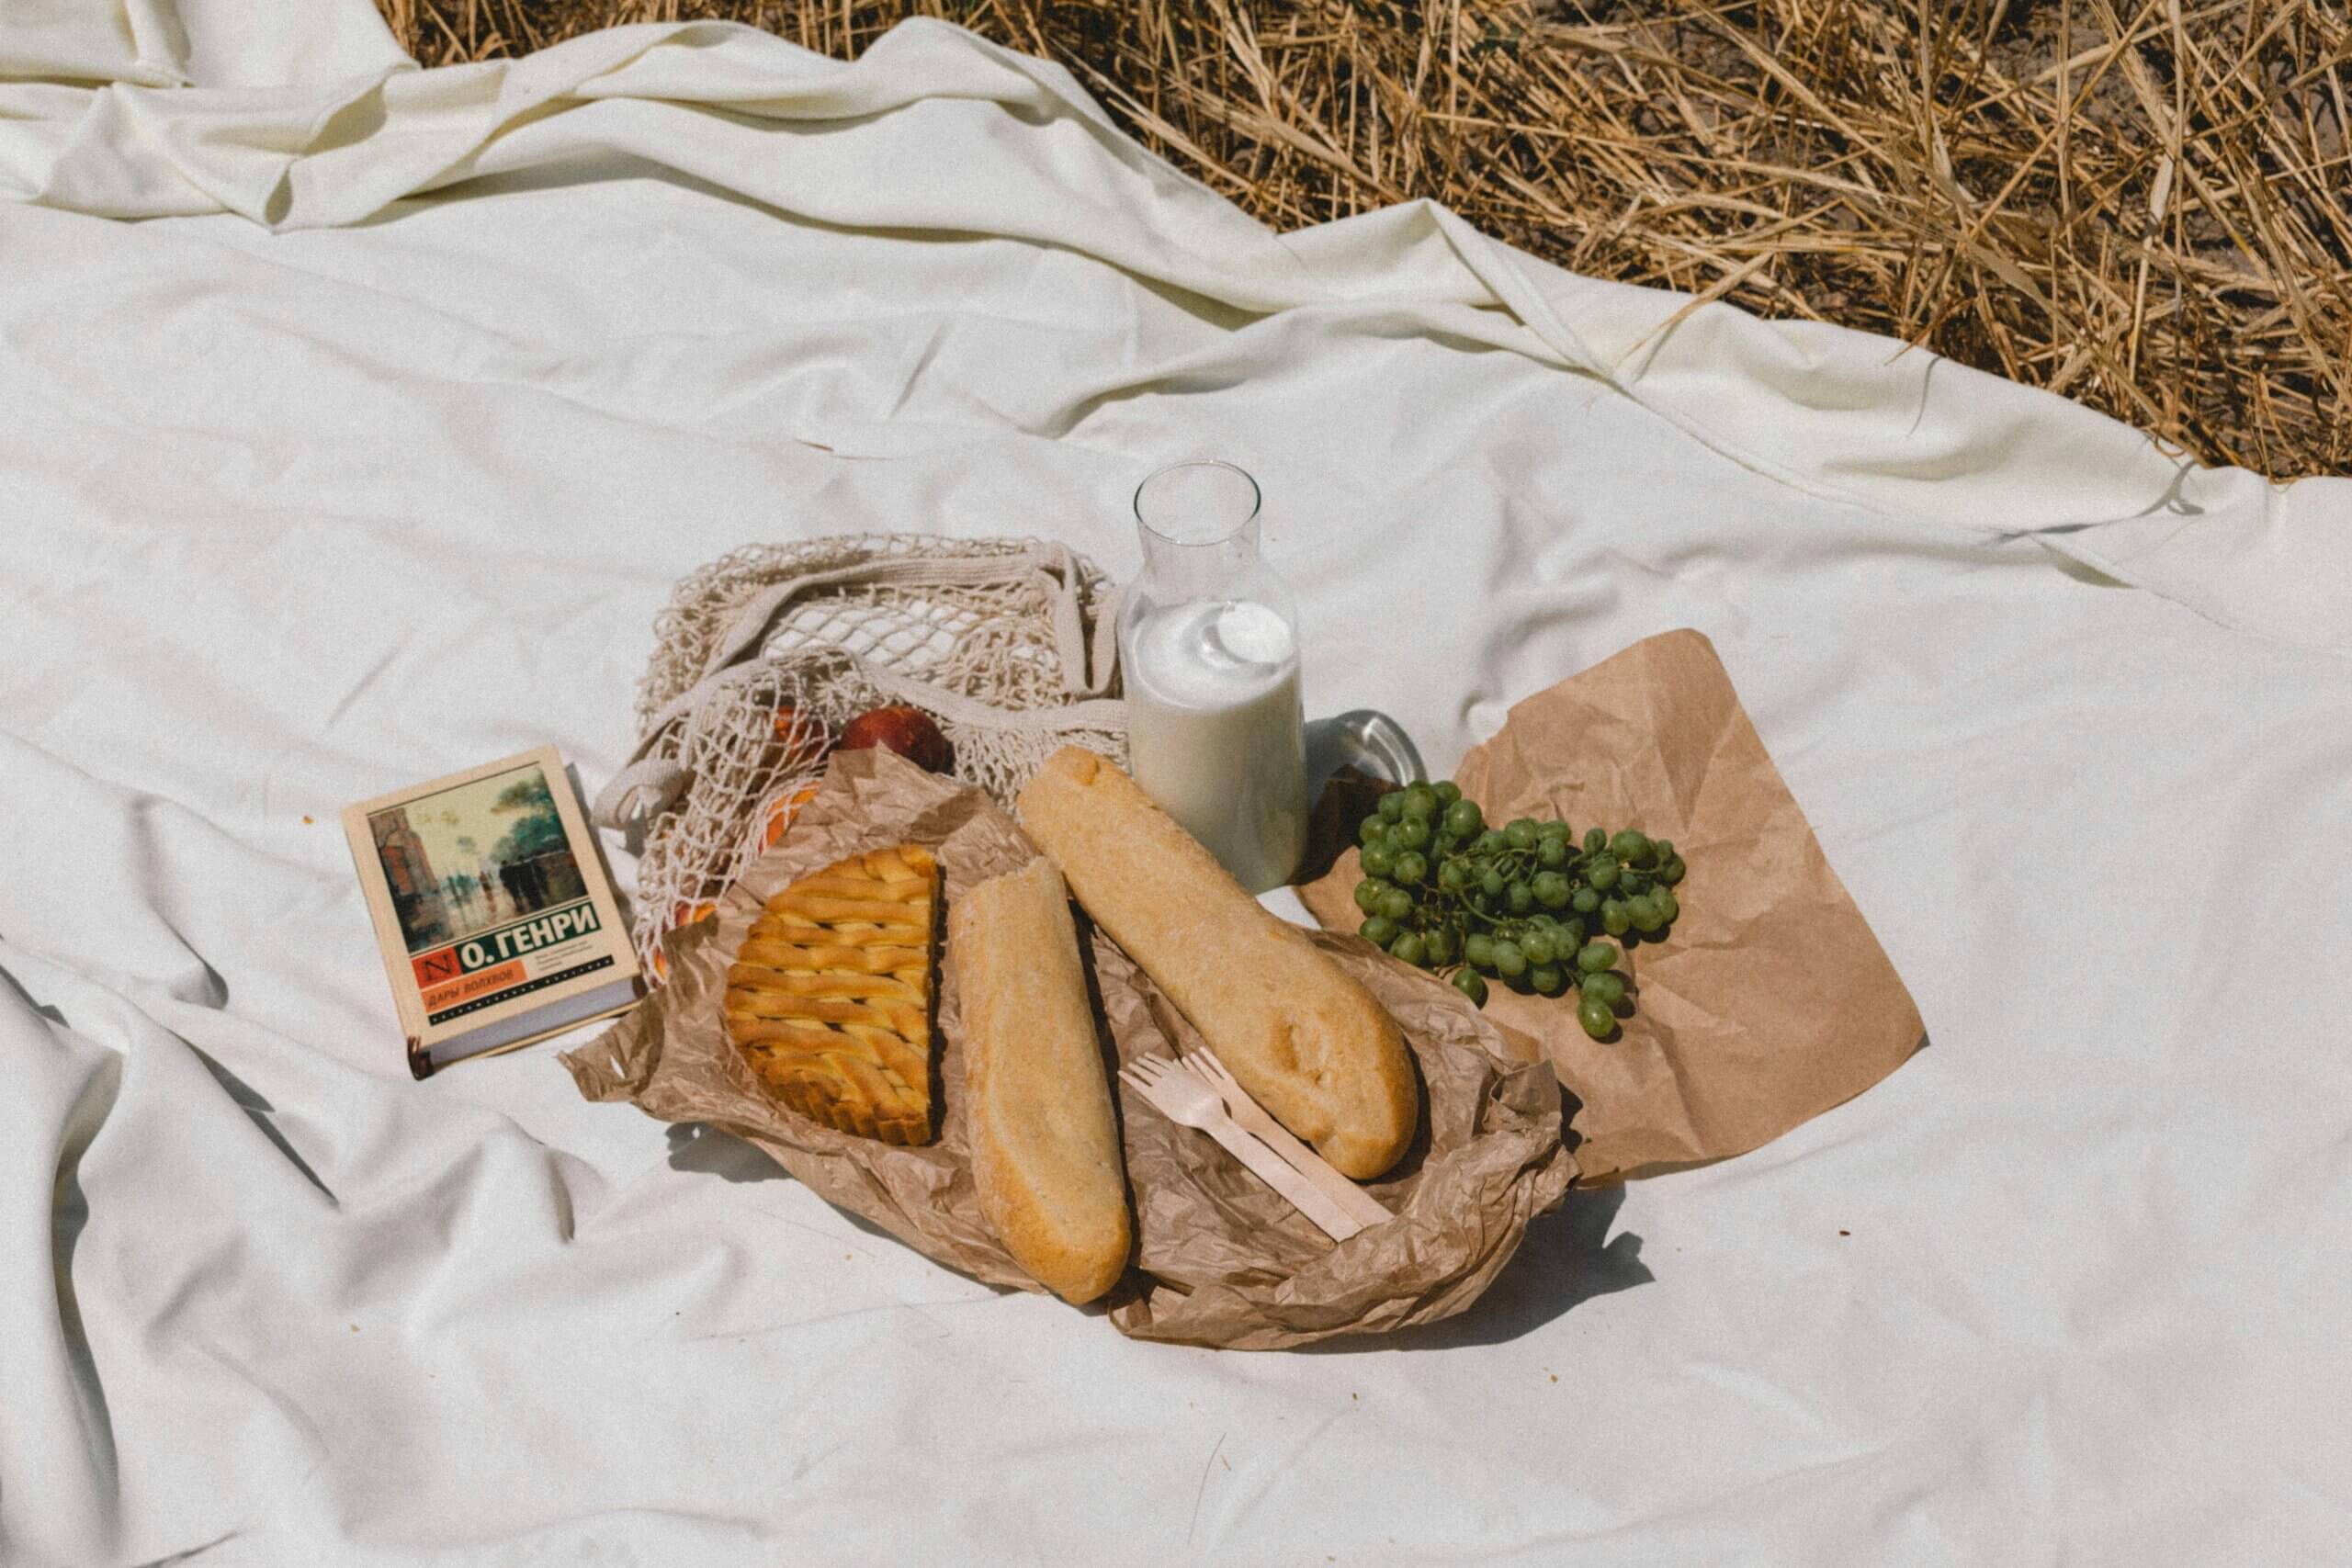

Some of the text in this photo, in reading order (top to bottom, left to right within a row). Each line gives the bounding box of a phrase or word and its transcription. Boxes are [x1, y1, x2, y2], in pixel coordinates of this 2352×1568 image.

[460, 942, 494, 968] О.
[495, 905, 597, 958] ГЕНРИ
[423, 953, 453, 982] N
[428, 987, 459, 1008] ДАРЫ
[464, 969, 514, 993] ВОЛХВОВ
